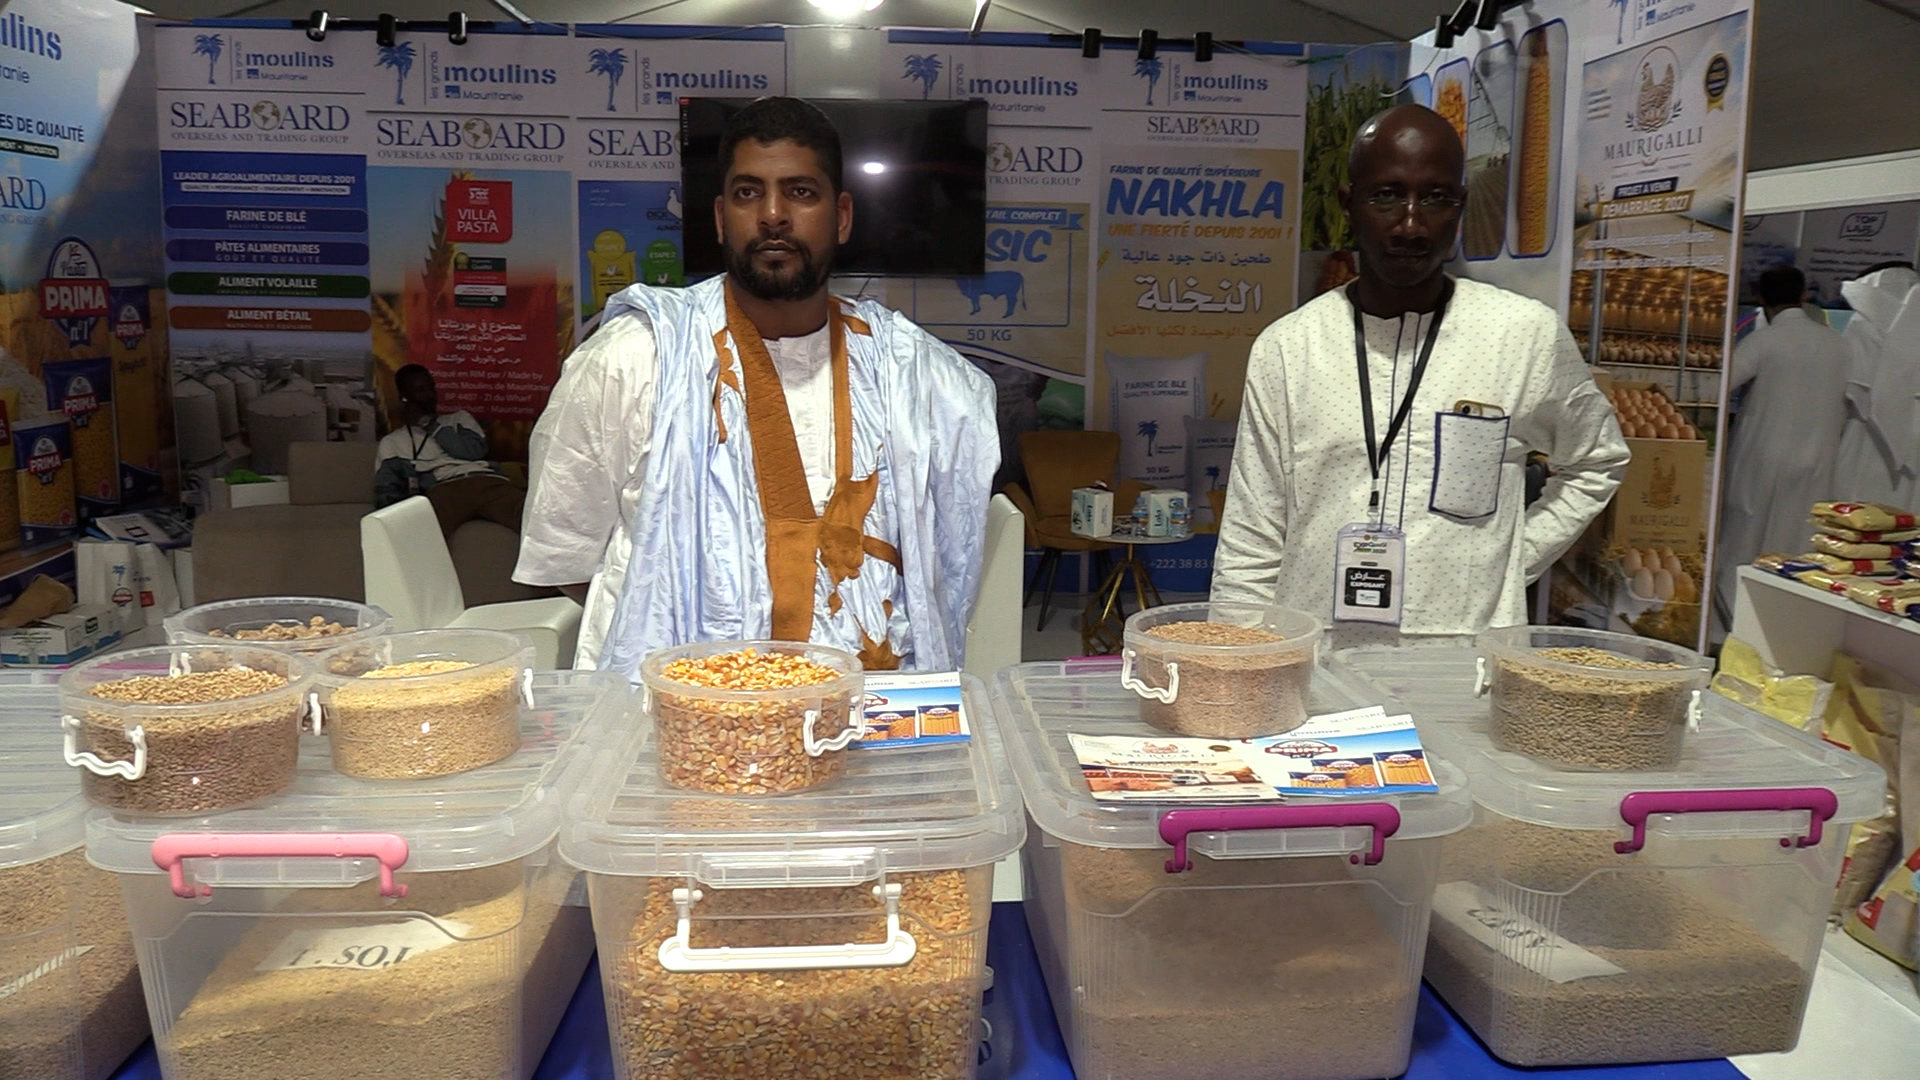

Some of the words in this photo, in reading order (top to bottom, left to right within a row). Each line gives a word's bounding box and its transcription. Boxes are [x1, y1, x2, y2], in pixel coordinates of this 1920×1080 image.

[245, 51, 335, 69] moulins
[260, 72, 309, 82] Mauritanie
[444, 64, 557, 85] moulins
[655, 69, 768, 90] moulins
[968, 76, 1079, 97] moulins
[1183, 74, 1269, 91] moulins
[462, 89, 524, 102] Mauritanie
[1197, 94, 1244, 103] Mauritanie
[171, 101, 351, 132] SEABOARD
[16, 116, 33, 134] DE
[36, 125, 85, 144] QUALITÉ
[1147, 115, 1260, 136] SEABOARD
[172, 131, 228, 143] OVERSEAS
[233, 132, 253, 142] AND
[257, 133, 308, 144] TRADING
[311, 135, 350, 145] GROUP
[376, 118, 566, 150] SEABOARD
[1603, 126, 1704, 162] MAURIGALLI
[377, 149, 437, 161] OVERSEAS
[439, 151, 464, 161] AND
[468, 152, 521, 163] TRADING
[523, 153, 565, 164] GROUP
[588, 159, 648, 170] OVERSEAS
[650, 160, 676, 170] AND
[1109, 165, 1144, 176] FARINE
[1146, 165, 1162, 176] DE
[1162, 163, 1203, 177] QUALITÉ
[172, 172, 209, 182] LEADER
[211, 173, 298, 184] AGROALIMENTAIRE
[298, 174, 334, 184] DEPUIS
[333, 175, 356, 185] 2001
[988, 175, 1039, 186] TRADING
[1042, 176, 1081, 187] GROUP
[1106, 177, 1285, 220] NAKHLA
[457, 208, 498, 221] VILLA
[1602, 198, 1663, 219] DÉMARRAGE
[226, 210, 266, 222] FARINE
[268, 211, 284, 222] DE
[286, 209, 308, 223] BLÉ
[986, 210, 1007, 221] TAIL
[1010, 210, 1063, 222] COMPLET
[456, 221, 499, 234] PASTA
[1108, 222, 1137, 237] UNE
[1140, 220, 1191, 238] FIERTÉ
[1193, 224, 1245, 239] DEPUIS
[1248, 226, 1281, 240] 2001
[215, 241, 246, 252] PÂTES
[247, 243, 321, 255] ALIMENTAIRES
[253, 255, 265, 263] ET
[218, 277, 265, 288] ALIMENT
[265, 277, 318, 289] VOLAILLE
[44, 285, 108, 314] PRIMA
[1134, 274, 1264, 314] النخلة
[227, 309, 274, 321] ALIMENT
[274, 310, 312, 322] BÉTAIL
[967, 329, 986, 341] 50
[990, 329, 1012, 342] KG
[434, 382, 459, 391] rands
[1124, 380, 1155, 390] FARINE
[63, 395, 98, 415] PRIMA
[29, 453, 63, 473] PRIMA
[1178, 558, 1193, 570] 38
[1194, 558, 1209, 570] 83
